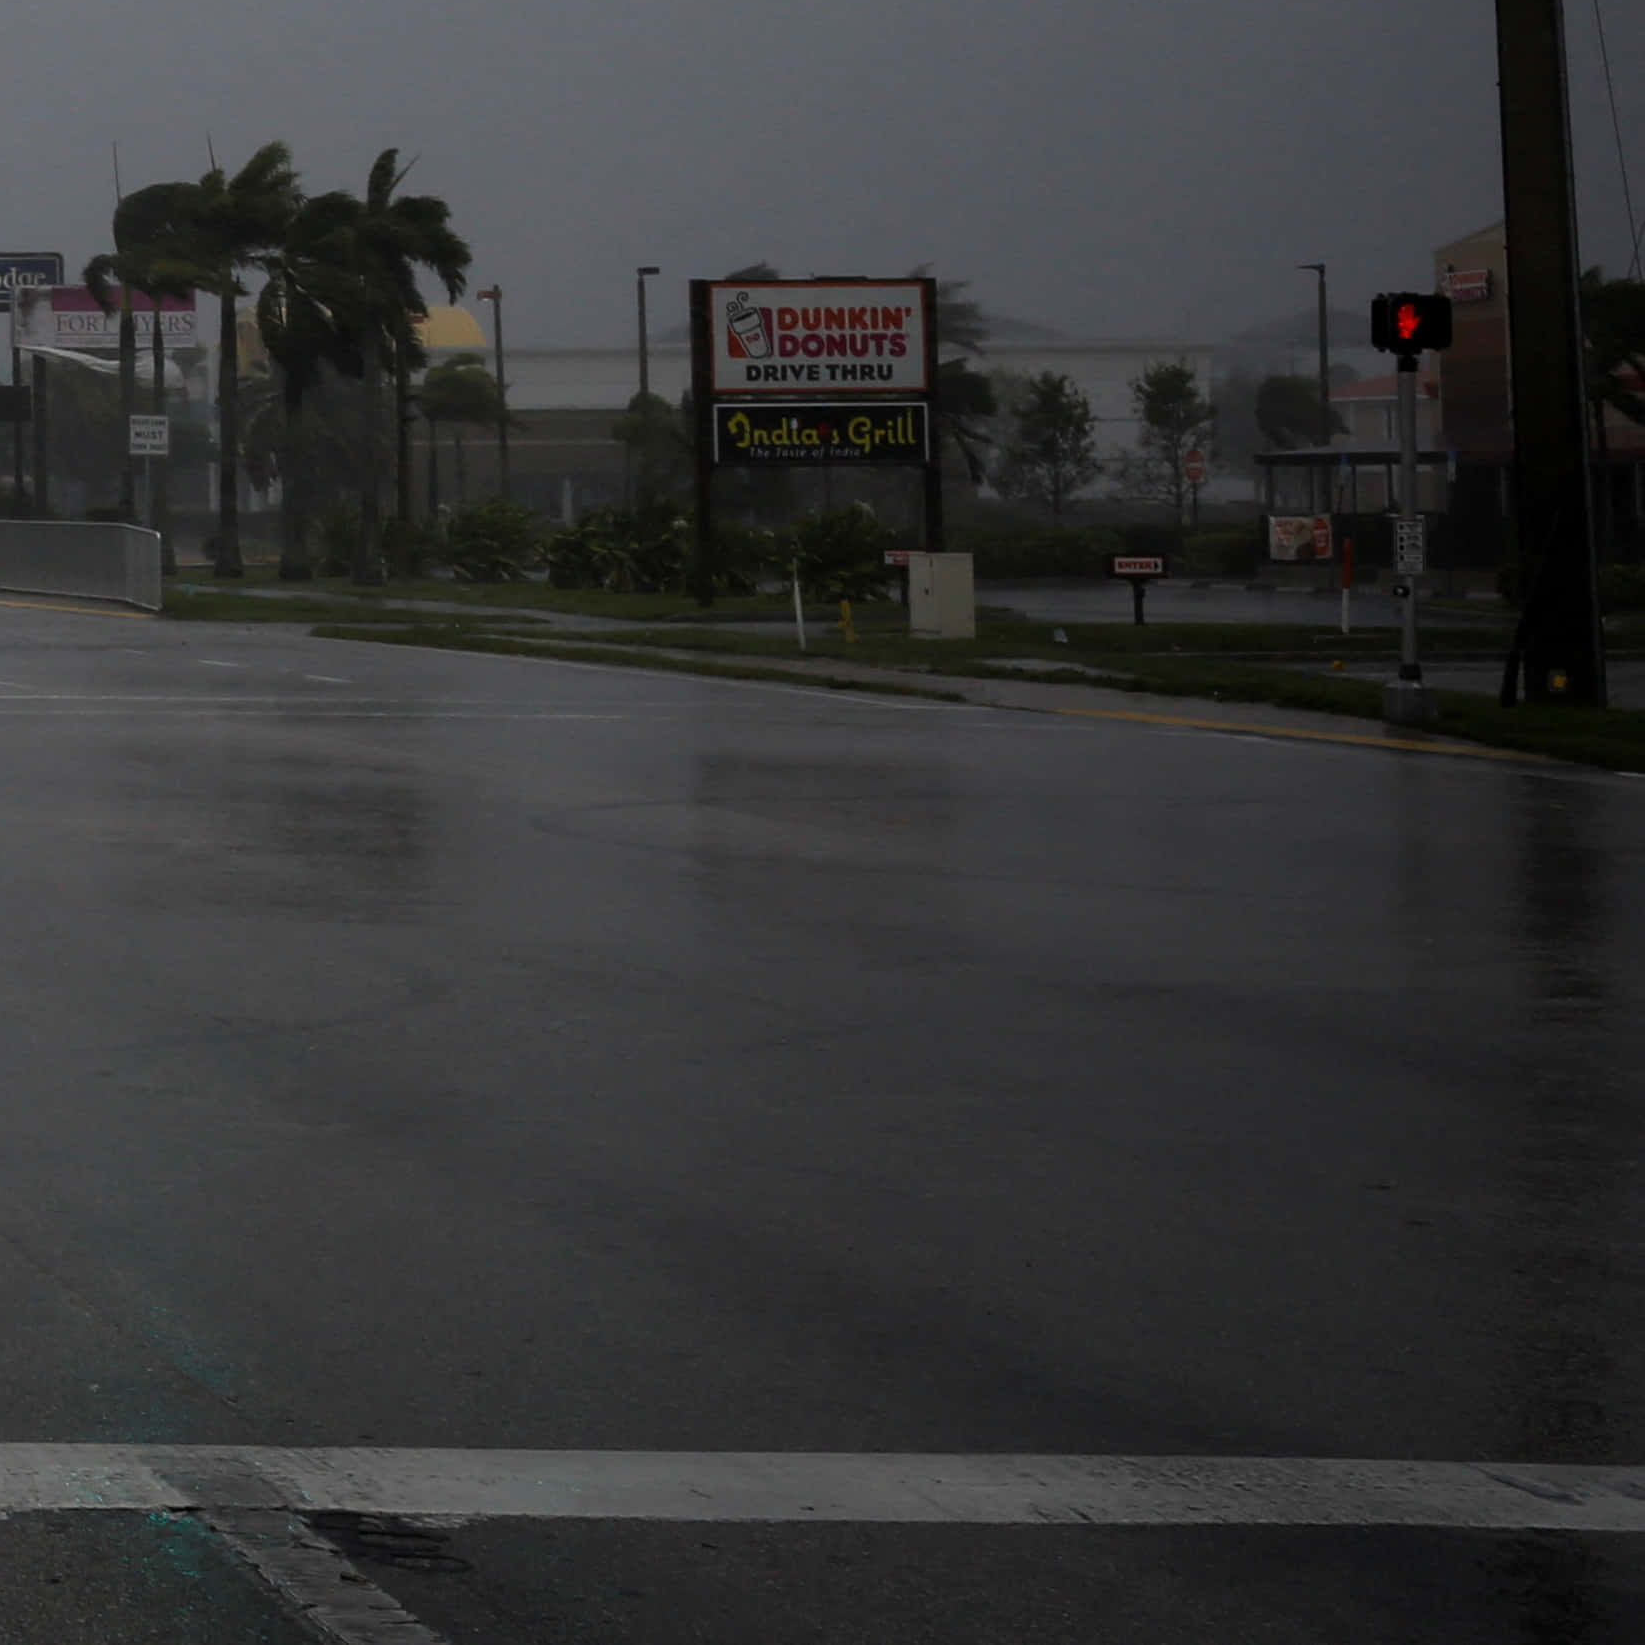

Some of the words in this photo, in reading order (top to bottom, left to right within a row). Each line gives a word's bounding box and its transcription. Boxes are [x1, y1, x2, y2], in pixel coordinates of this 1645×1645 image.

[777, 306, 912, 331] DUNKIN'
[778, 333, 907, 358] DONUTS
[746, 364, 820, 382] DRIVE
[826, 363, 894, 382] THRU
[134, 431, 166, 441] MUST
[847, 407, 917, 453] Grill
